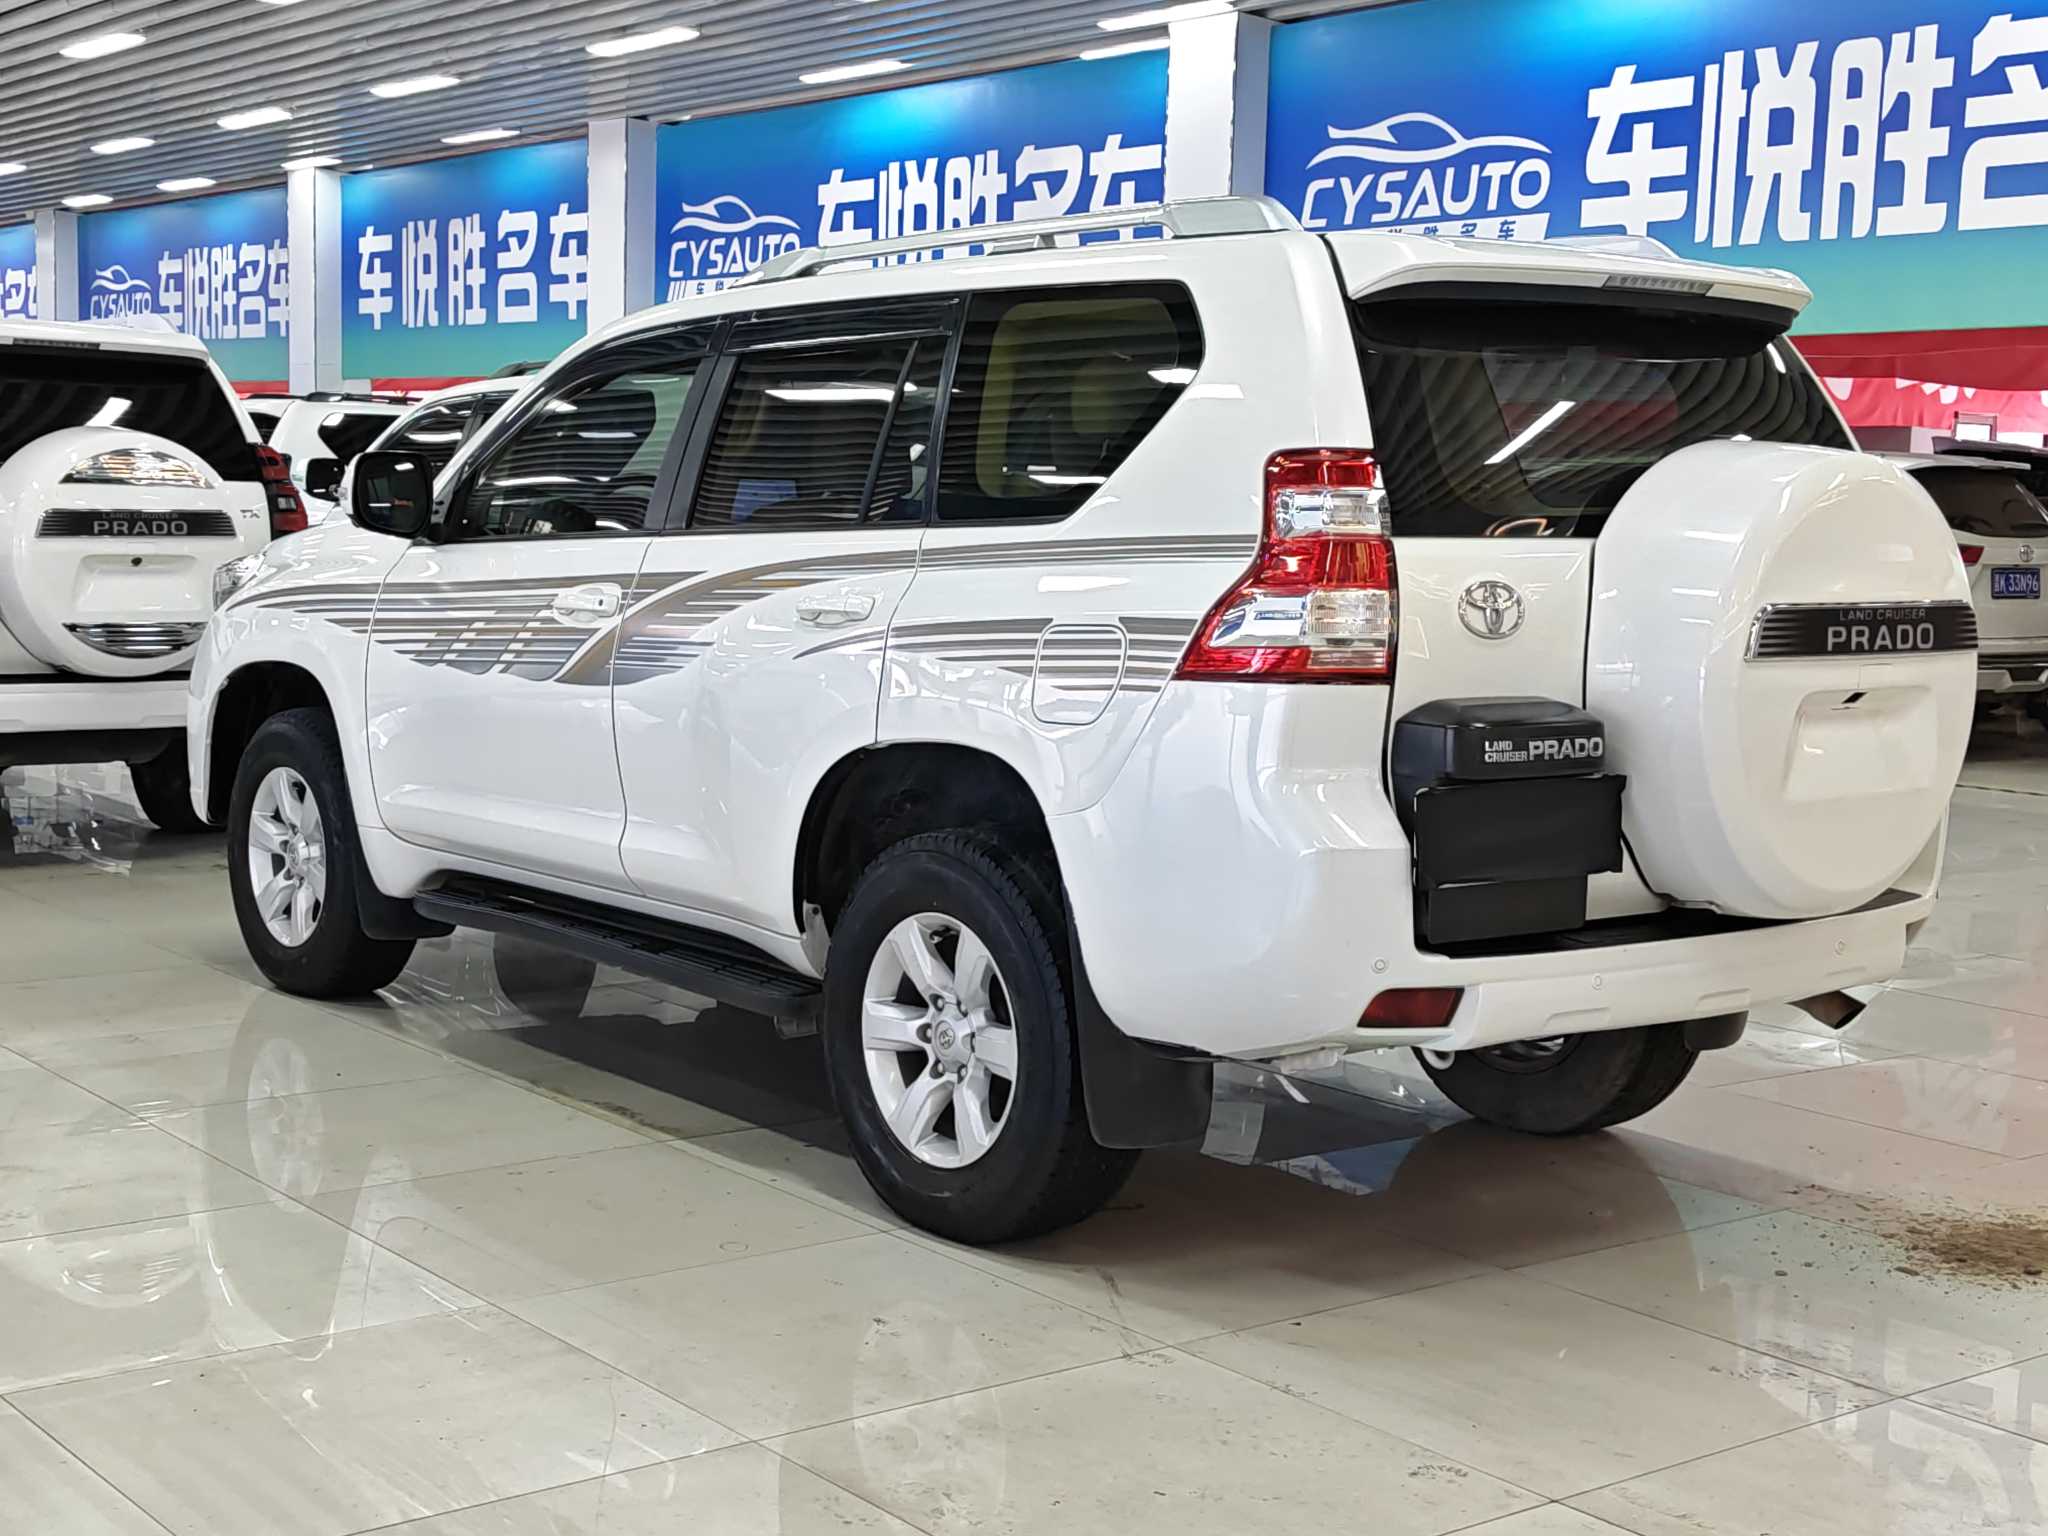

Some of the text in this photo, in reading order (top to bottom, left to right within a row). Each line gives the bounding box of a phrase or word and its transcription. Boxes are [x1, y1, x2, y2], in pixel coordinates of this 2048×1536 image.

[1300, 157, 1551, 229] CYSAUTO
[357, 202, 588, 331] 车悦胜名车
[90, 291, 152, 321] CYSAUTO
[93, 520, 188, 535] PRADO
[1840, 607, 1927, 621] LAND CRUISER
[1826, 622, 1935, 652] PRADO
[1484, 740, 1513, 752] LAND
[1484, 751, 1529, 763] CRUISER
[1528, 736, 1604, 761] PRADO
